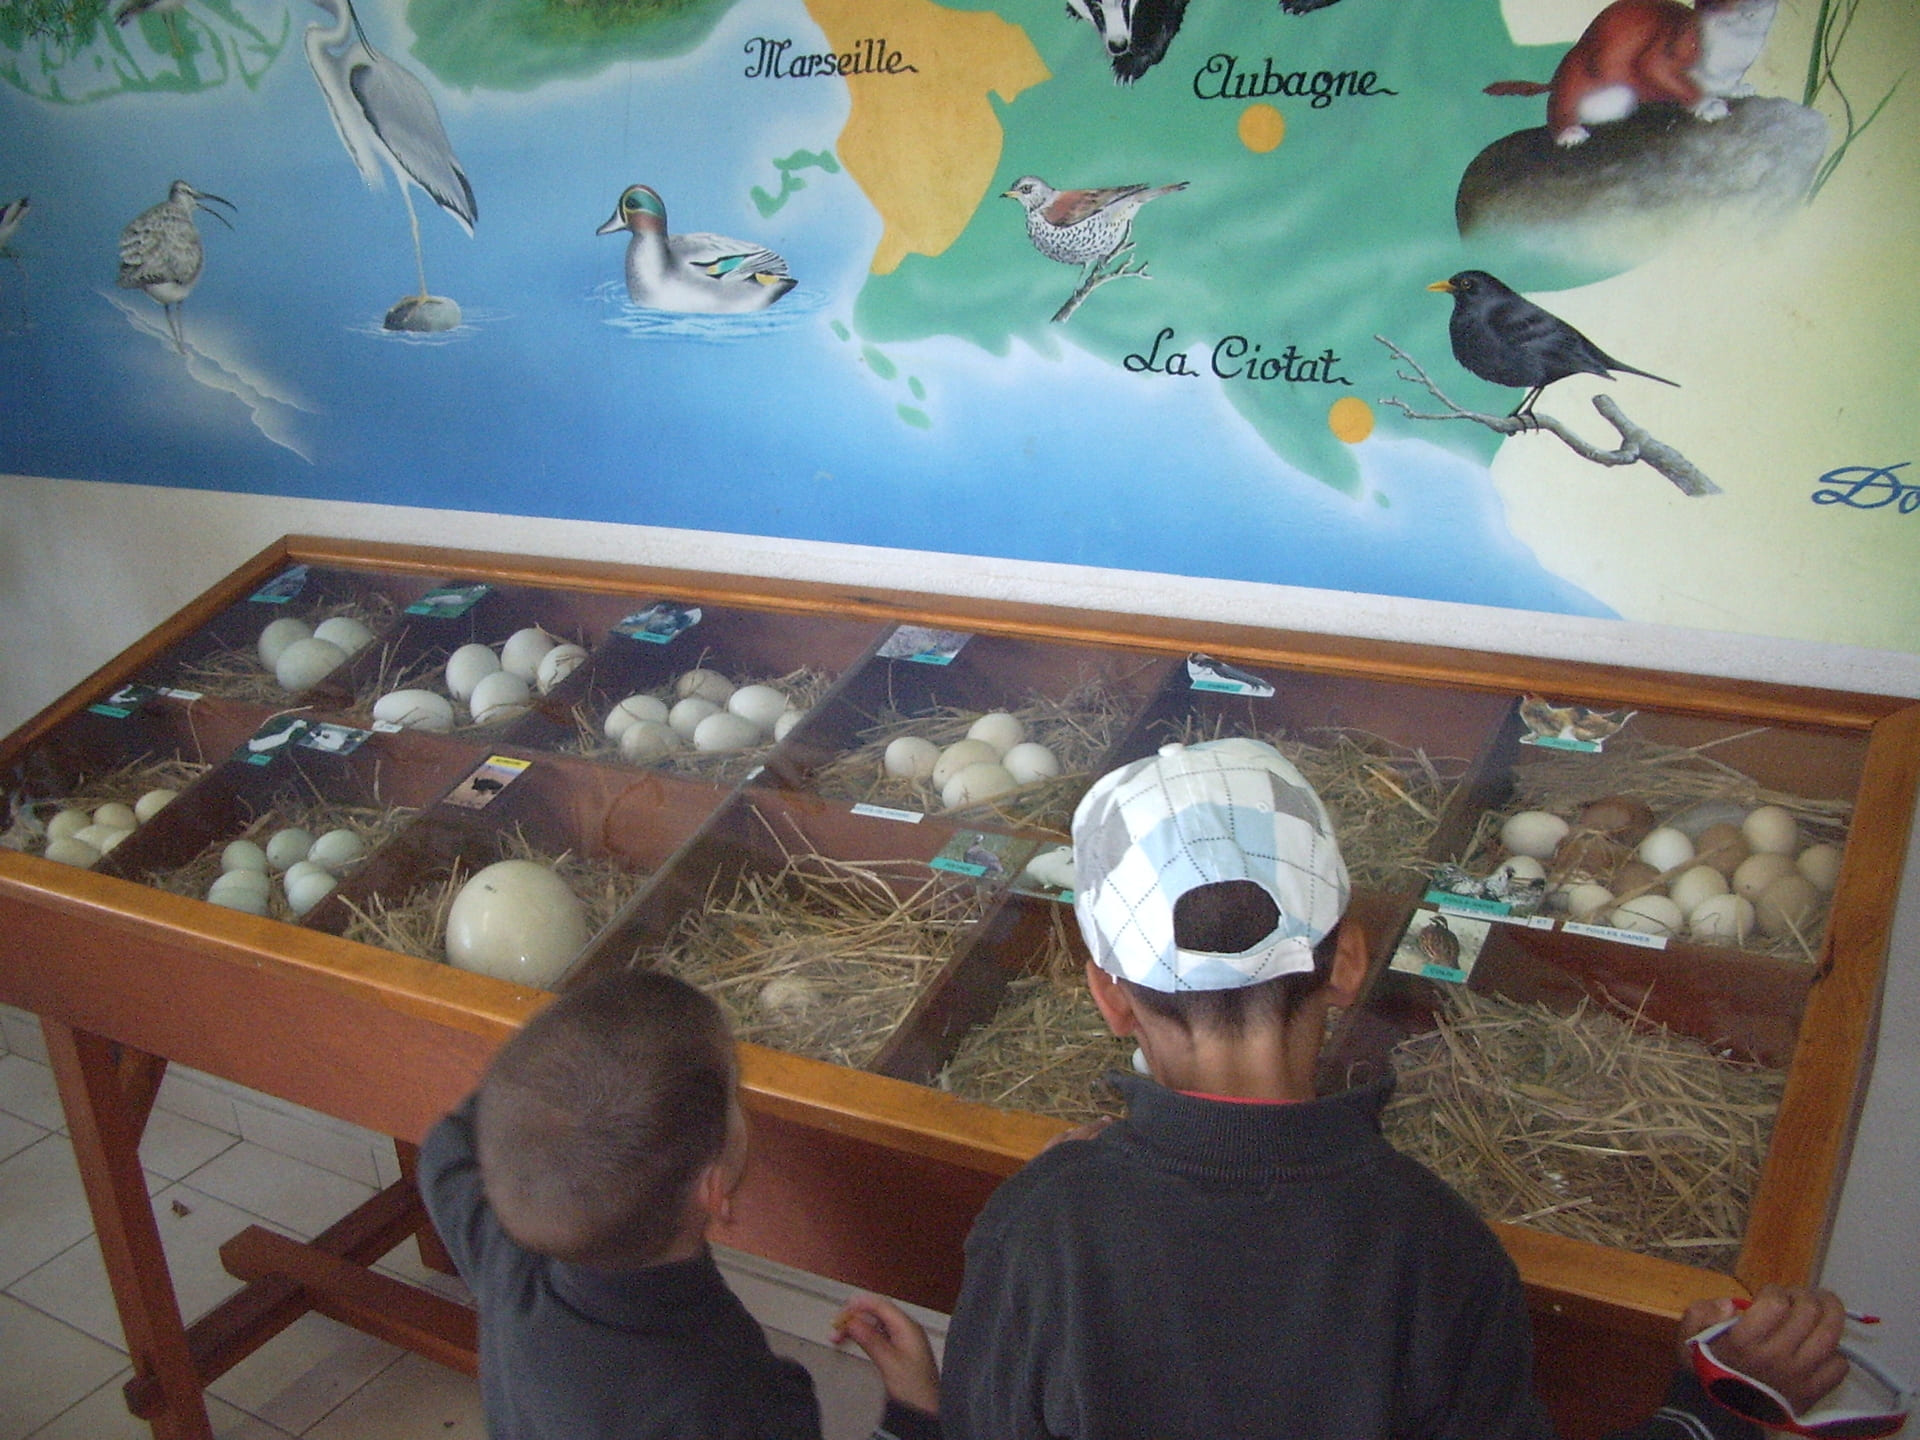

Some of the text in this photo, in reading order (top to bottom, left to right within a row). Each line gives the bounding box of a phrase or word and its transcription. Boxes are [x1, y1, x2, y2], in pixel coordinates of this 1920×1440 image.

[744, 37, 919, 79] Marseille
[1193, 53, 1399, 109] Aubagne
[1123, 327, 1354, 385] La Ciotat
